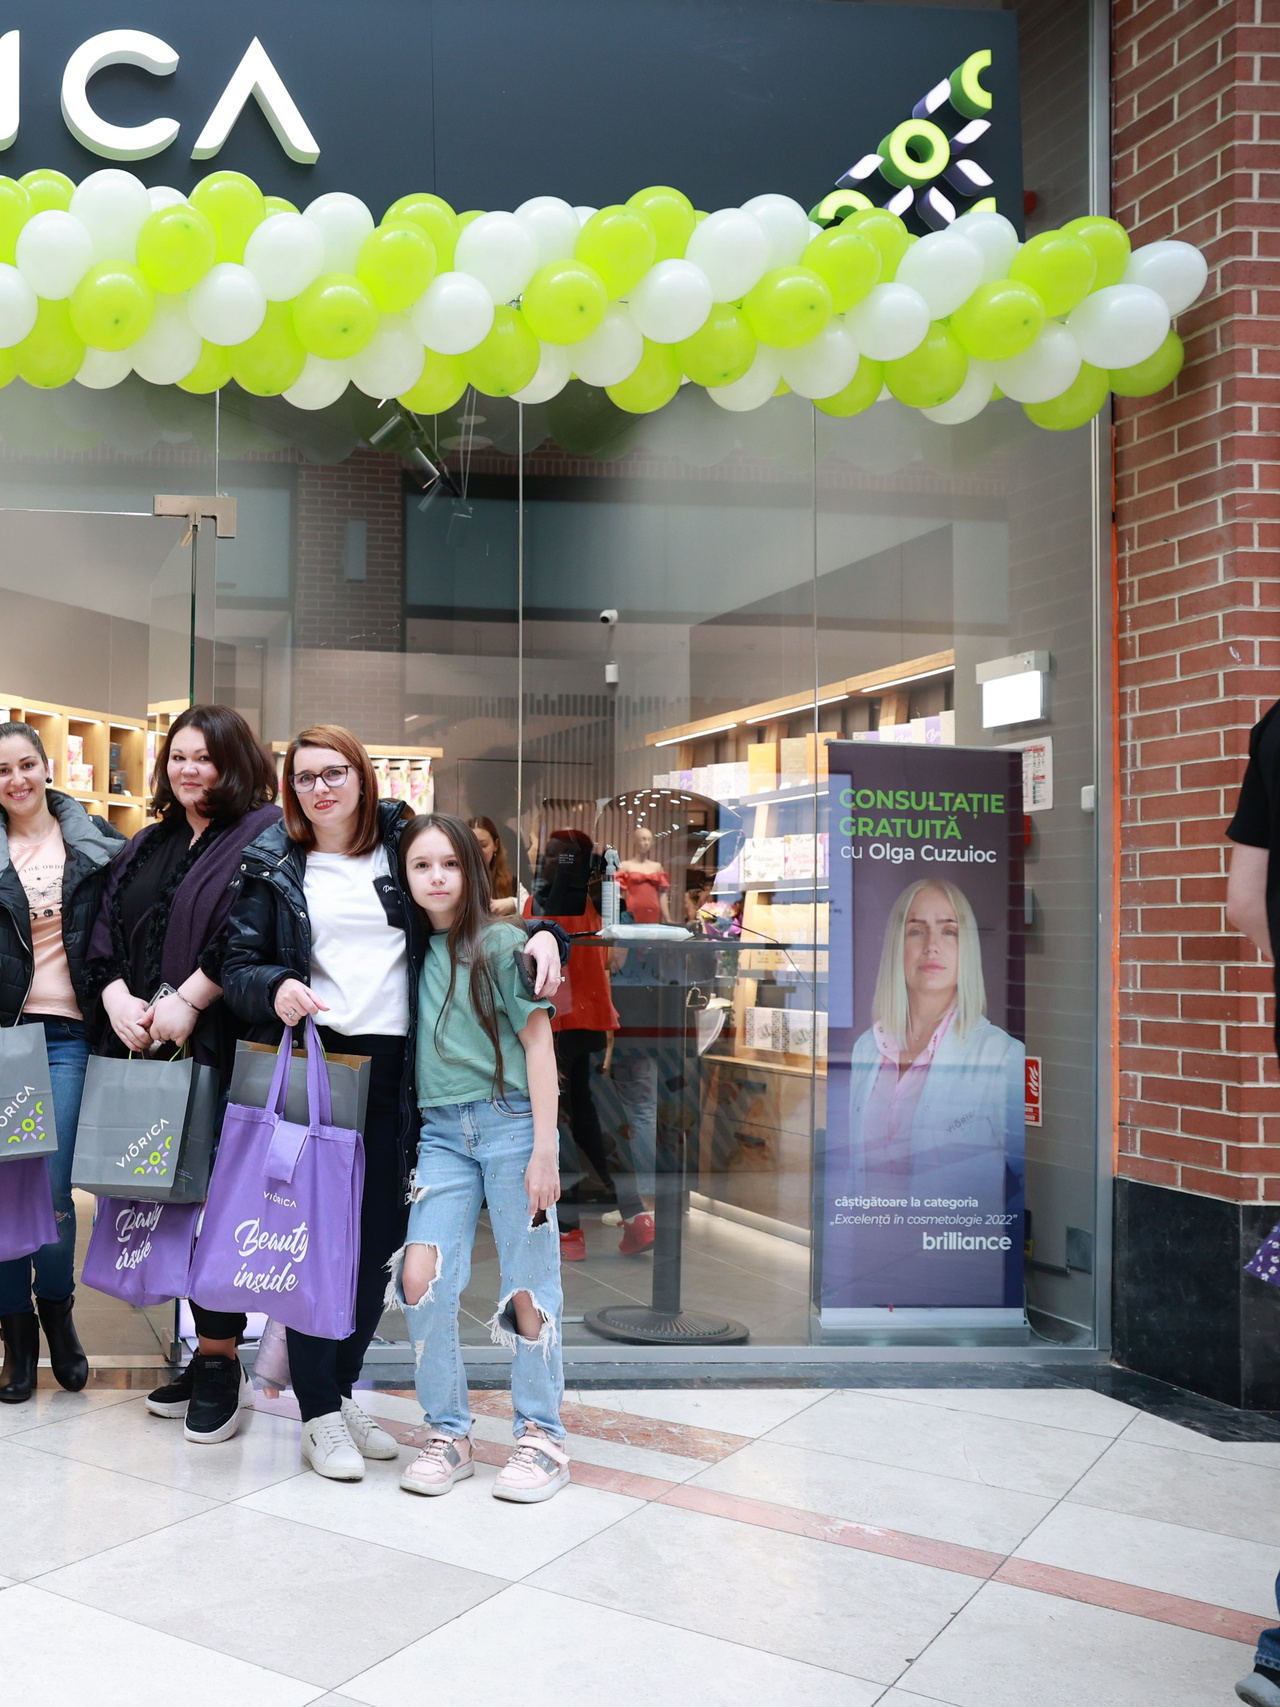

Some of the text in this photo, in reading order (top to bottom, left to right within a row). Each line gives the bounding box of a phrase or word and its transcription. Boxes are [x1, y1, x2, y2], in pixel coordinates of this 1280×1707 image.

[839, 788, 1005, 819] CONSULTAȚIE
[839, 815, 962, 840] GRATUITĂ
[841, 845, 863, 859] cu
[869, 843, 915, 864] Olga
[920, 845, 997, 863] Cuzuioc
[911, 1196, 921, 1207] la
[924, 1196, 979, 1210] categoria
[894, 1214, 904, 1225] în
[907, 1214, 983, 1227] cosmetologie
[234, 1217, 309, 1263] Beauty
[922, 1232, 1012, 1250] brilliance
[233, 1261, 299, 1293] inside
